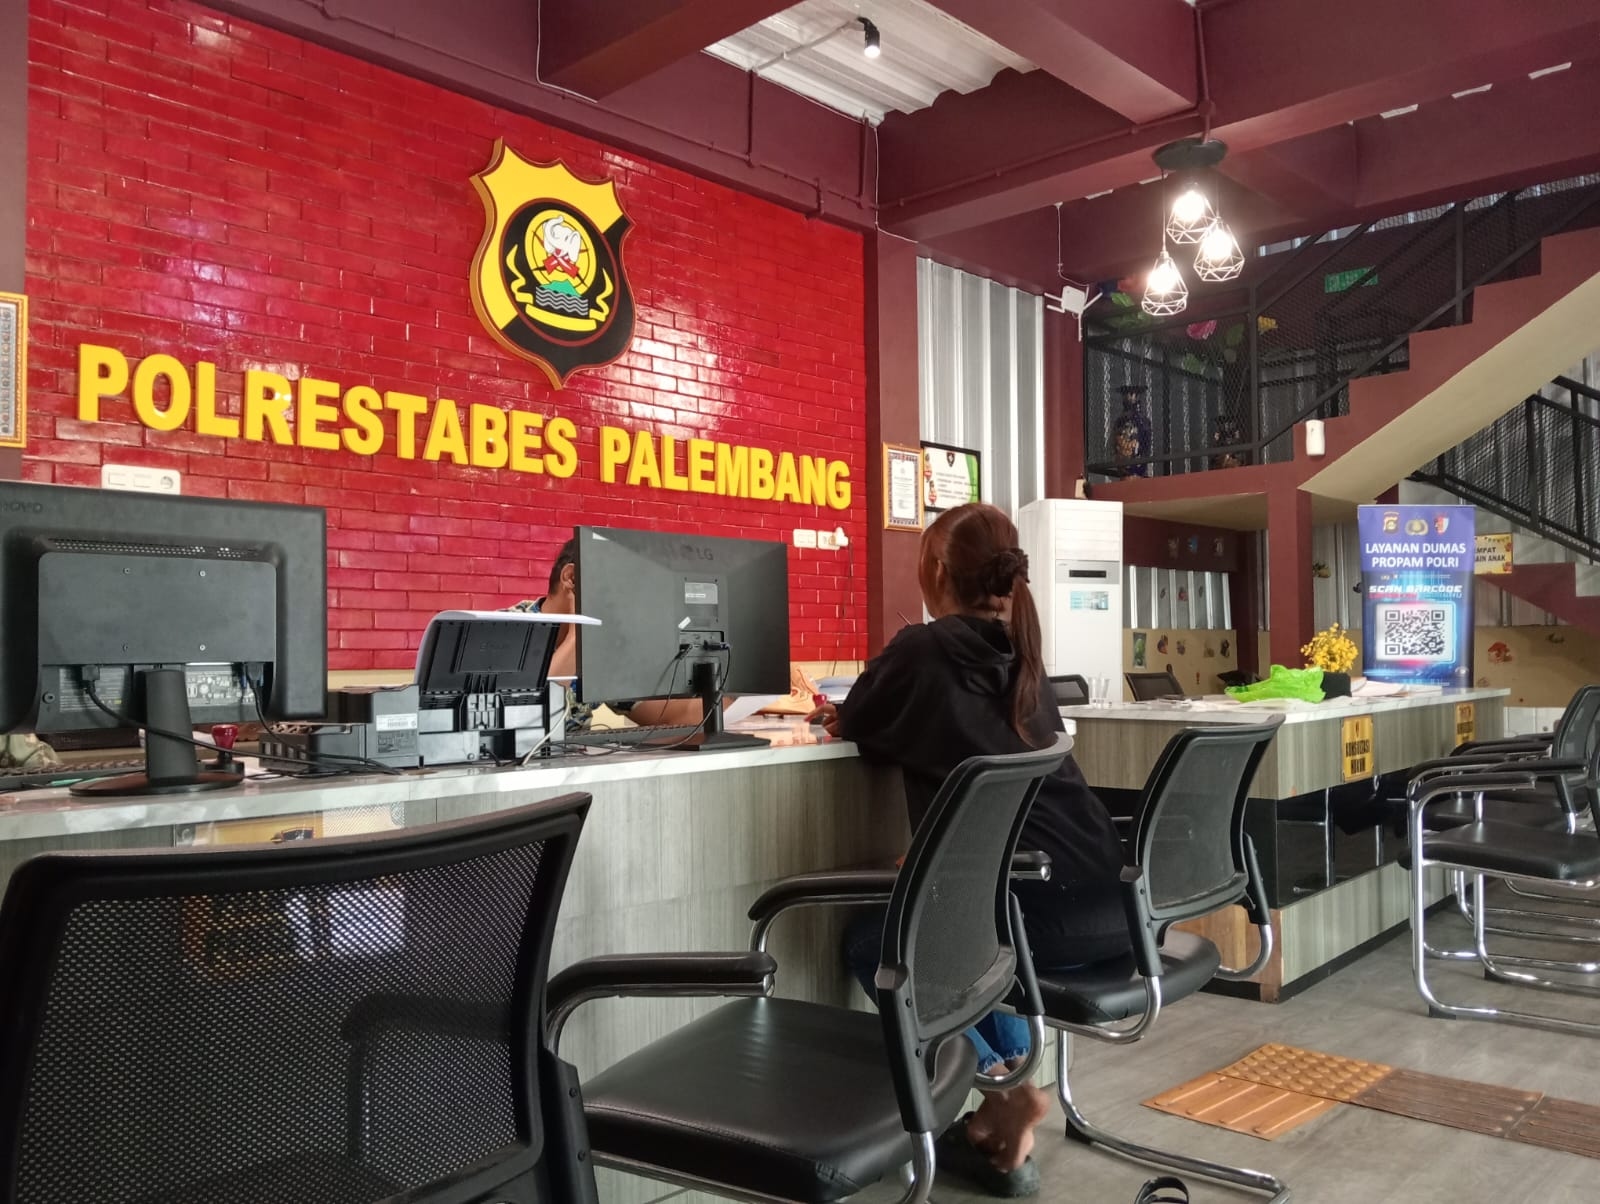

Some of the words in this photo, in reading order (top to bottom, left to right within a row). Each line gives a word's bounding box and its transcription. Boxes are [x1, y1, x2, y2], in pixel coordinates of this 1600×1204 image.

[78, 343, 578, 478] POLRESTABES
[601, 426, 852, 510] PALEMBANG
[1365, 543, 1420, 554] LAYANAN
[1422, 543, 1466, 554] DUMAS
[1371, 557, 1424, 568] PROPAM
[1426, 556, 1459, 568] POLRI
[1369, 584, 1402, 593] SCAN
[1405, 584, 1463, 593] BARCODE
